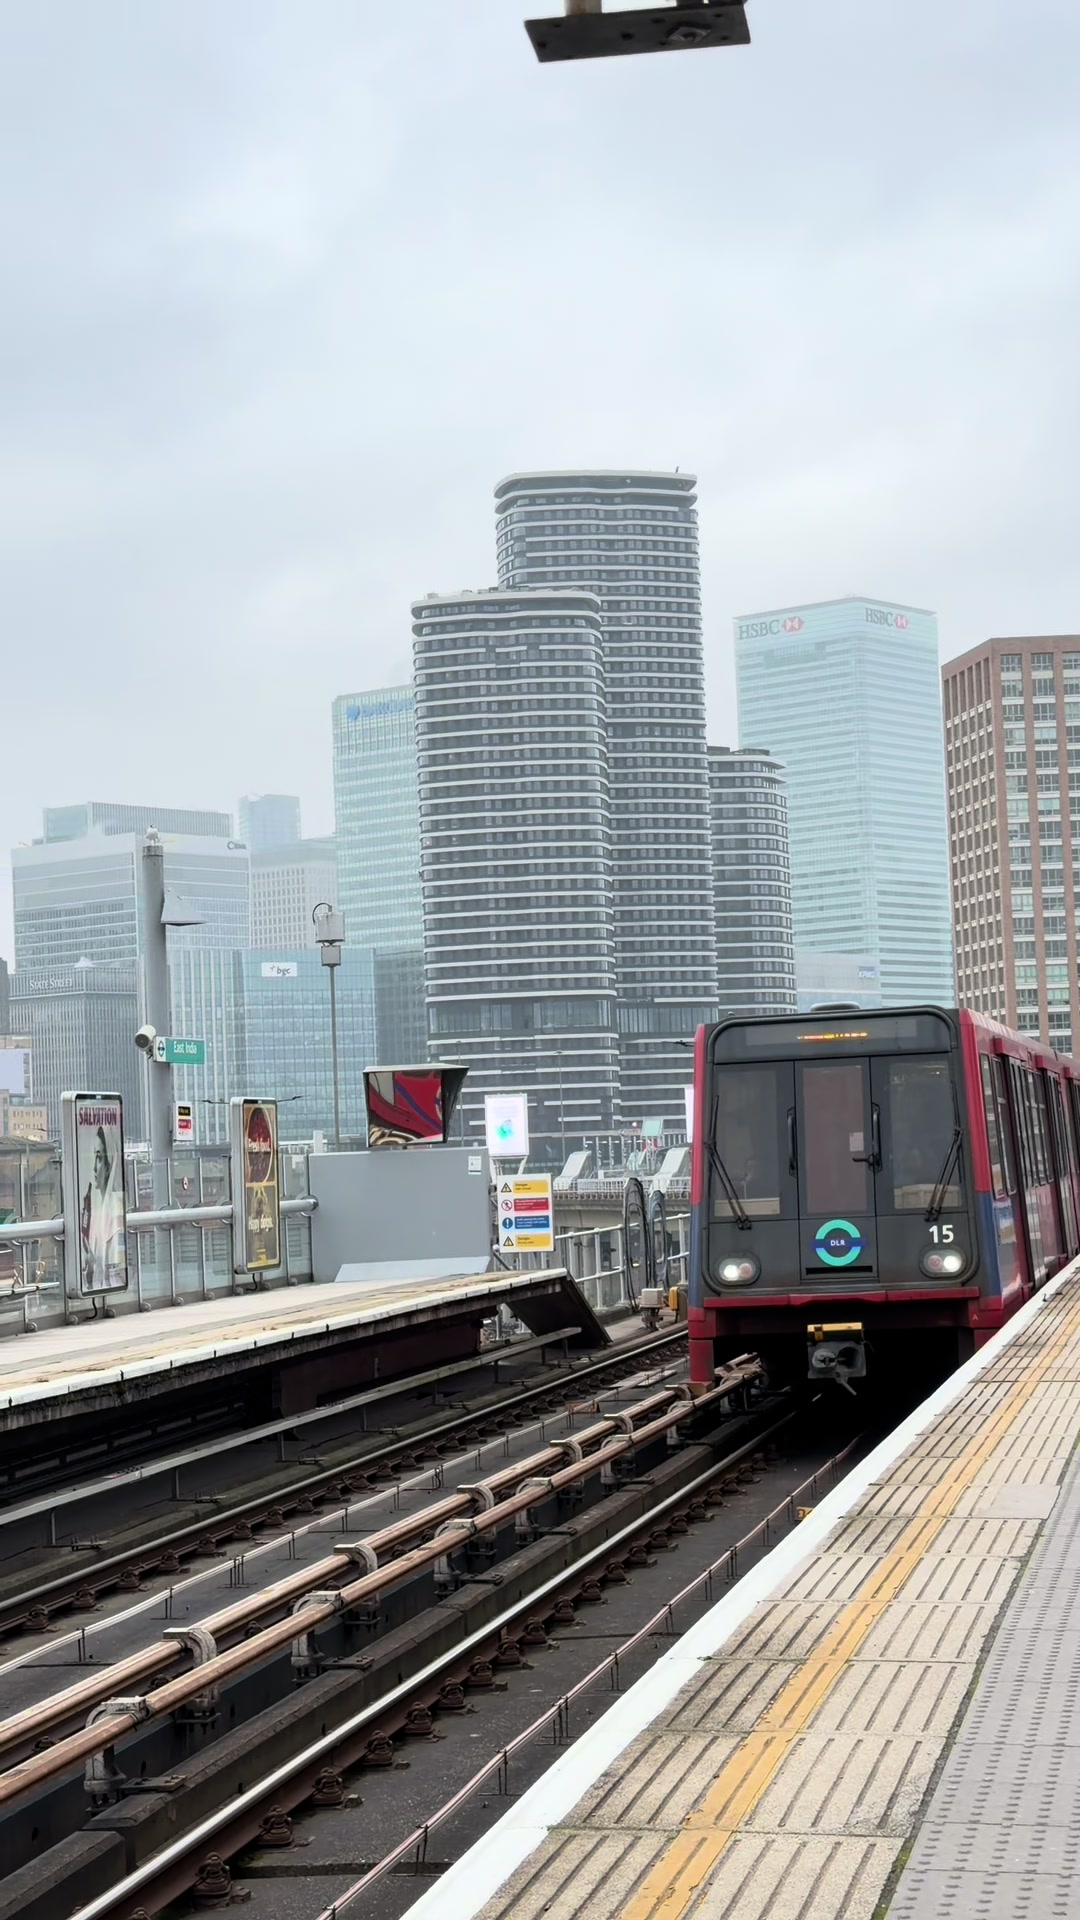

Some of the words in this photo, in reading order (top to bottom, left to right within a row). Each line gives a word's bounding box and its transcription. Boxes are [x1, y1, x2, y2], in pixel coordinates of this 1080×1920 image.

[865, 608, 893, 627] HSBC
[738, 619, 780, 640] HSBC
[173, 1041, 185, 1053] East
[79, 1106, 117, 1126] SALVATION
[830, 1239, 846, 1247] DLR
[928, 1224, 954, 1244] 15
